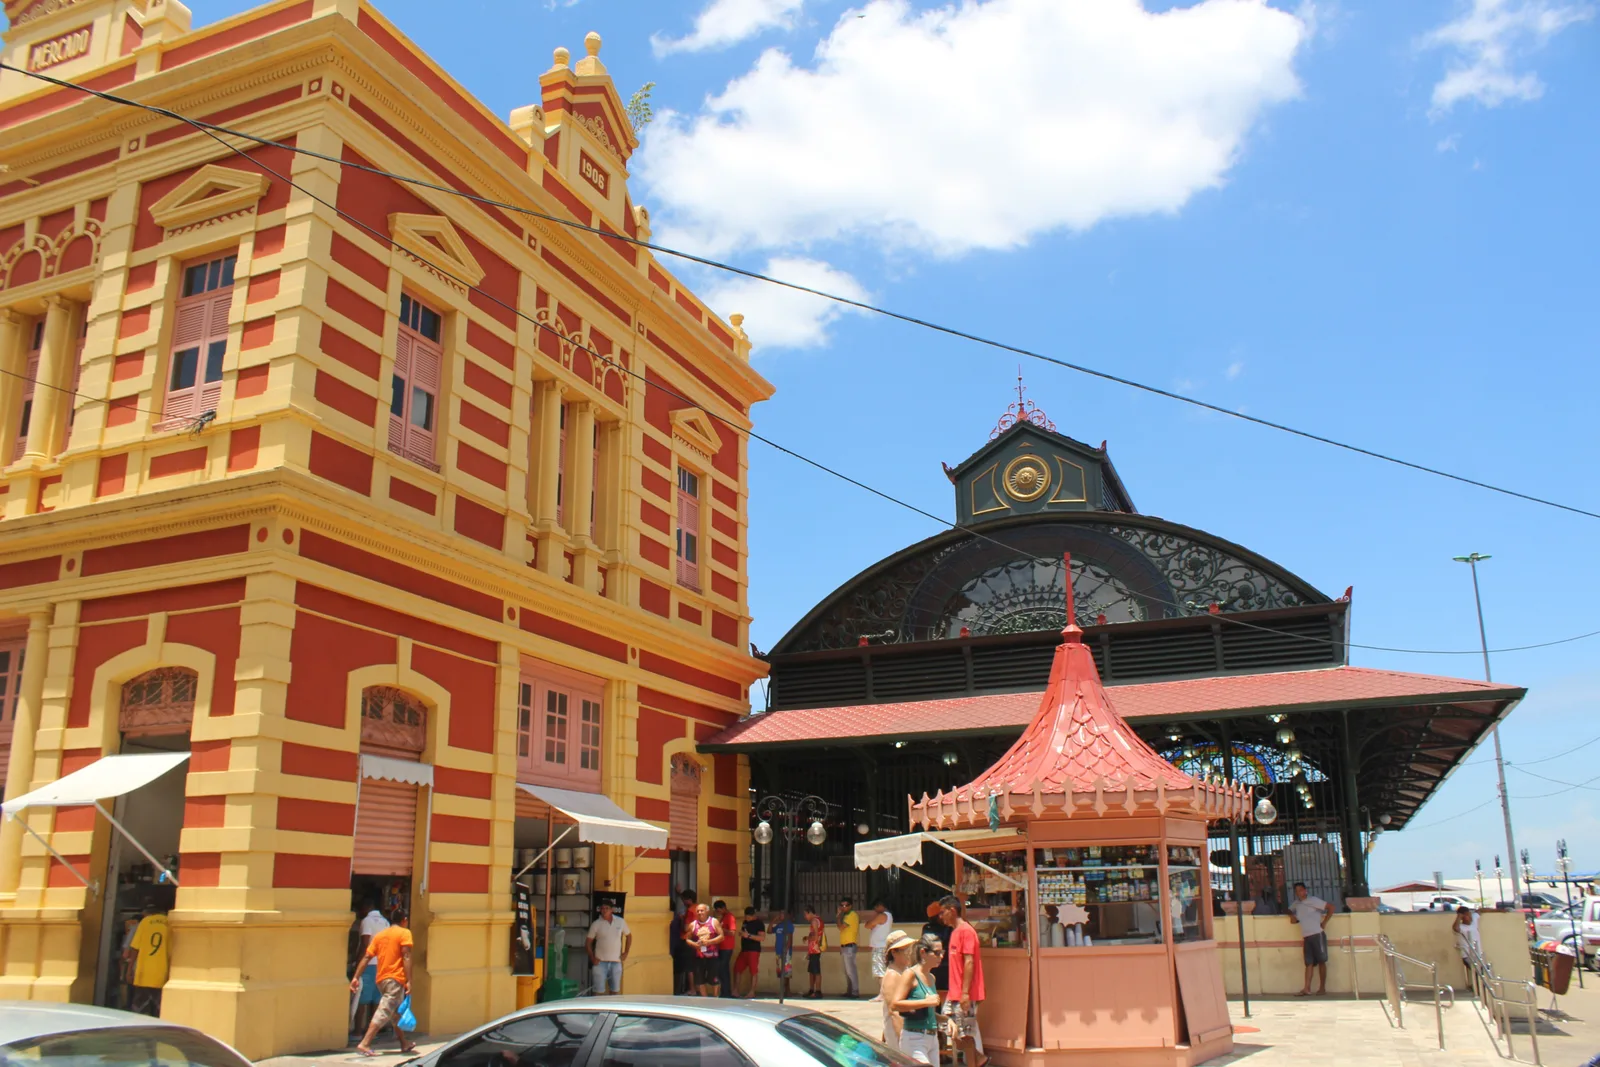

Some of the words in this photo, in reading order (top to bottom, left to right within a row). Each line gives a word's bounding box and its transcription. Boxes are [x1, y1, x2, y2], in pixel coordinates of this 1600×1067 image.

[32, 29, 90, 70] MERCADO
[582, 158, 605, 190] 1906
[149, 932, 162, 956] 9
